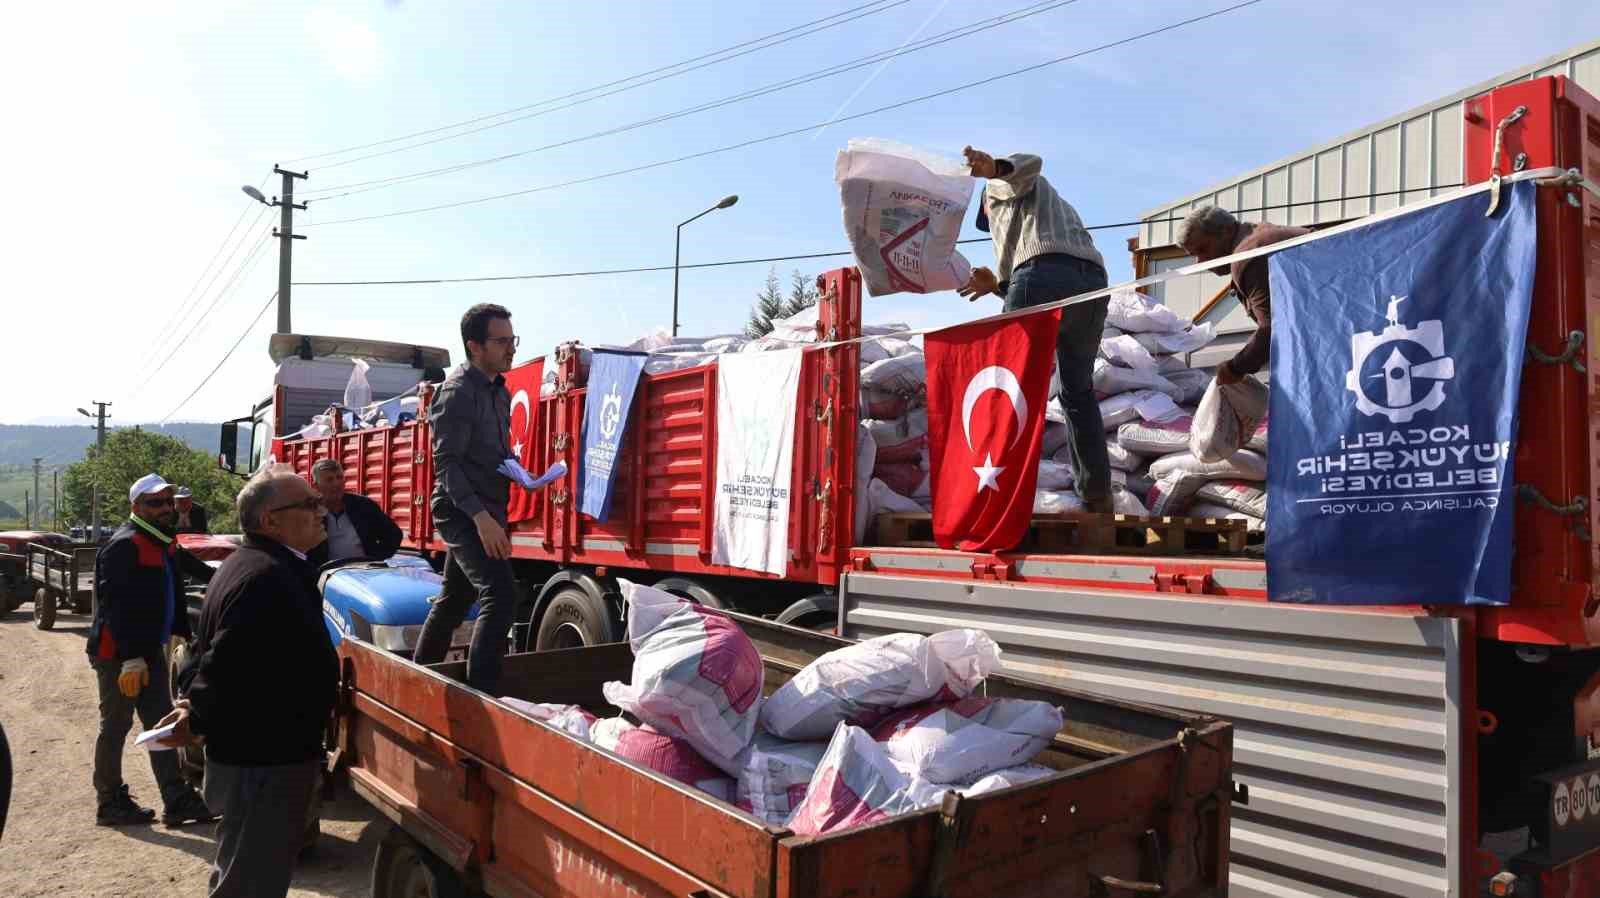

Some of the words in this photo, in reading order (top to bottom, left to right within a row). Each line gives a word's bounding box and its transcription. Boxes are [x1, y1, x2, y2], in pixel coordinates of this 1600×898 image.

[1555, 796, 1568, 816] TR
[1572, 788, 1584, 811] 80
[1588, 784, 1600, 806] 70
